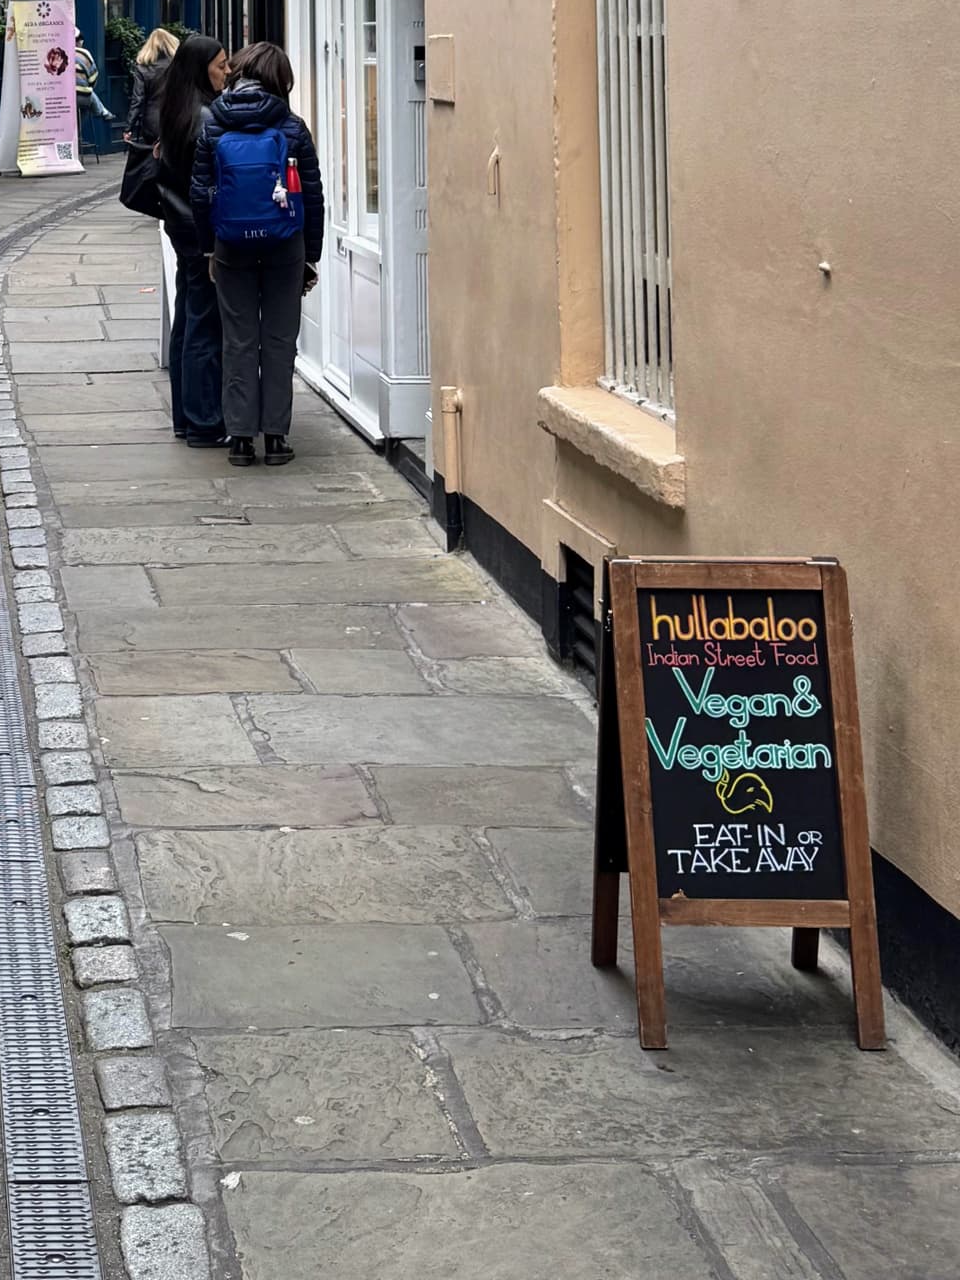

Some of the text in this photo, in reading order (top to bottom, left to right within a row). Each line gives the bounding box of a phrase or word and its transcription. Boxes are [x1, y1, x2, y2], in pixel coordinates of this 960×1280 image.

[650, 595, 817, 642] hullabaloo
[647, 641, 819, 668] Indian Street Food
[645, 717, 832, 782] Vegetarian
[667, 846, 820, 874] TAKE AWAY
